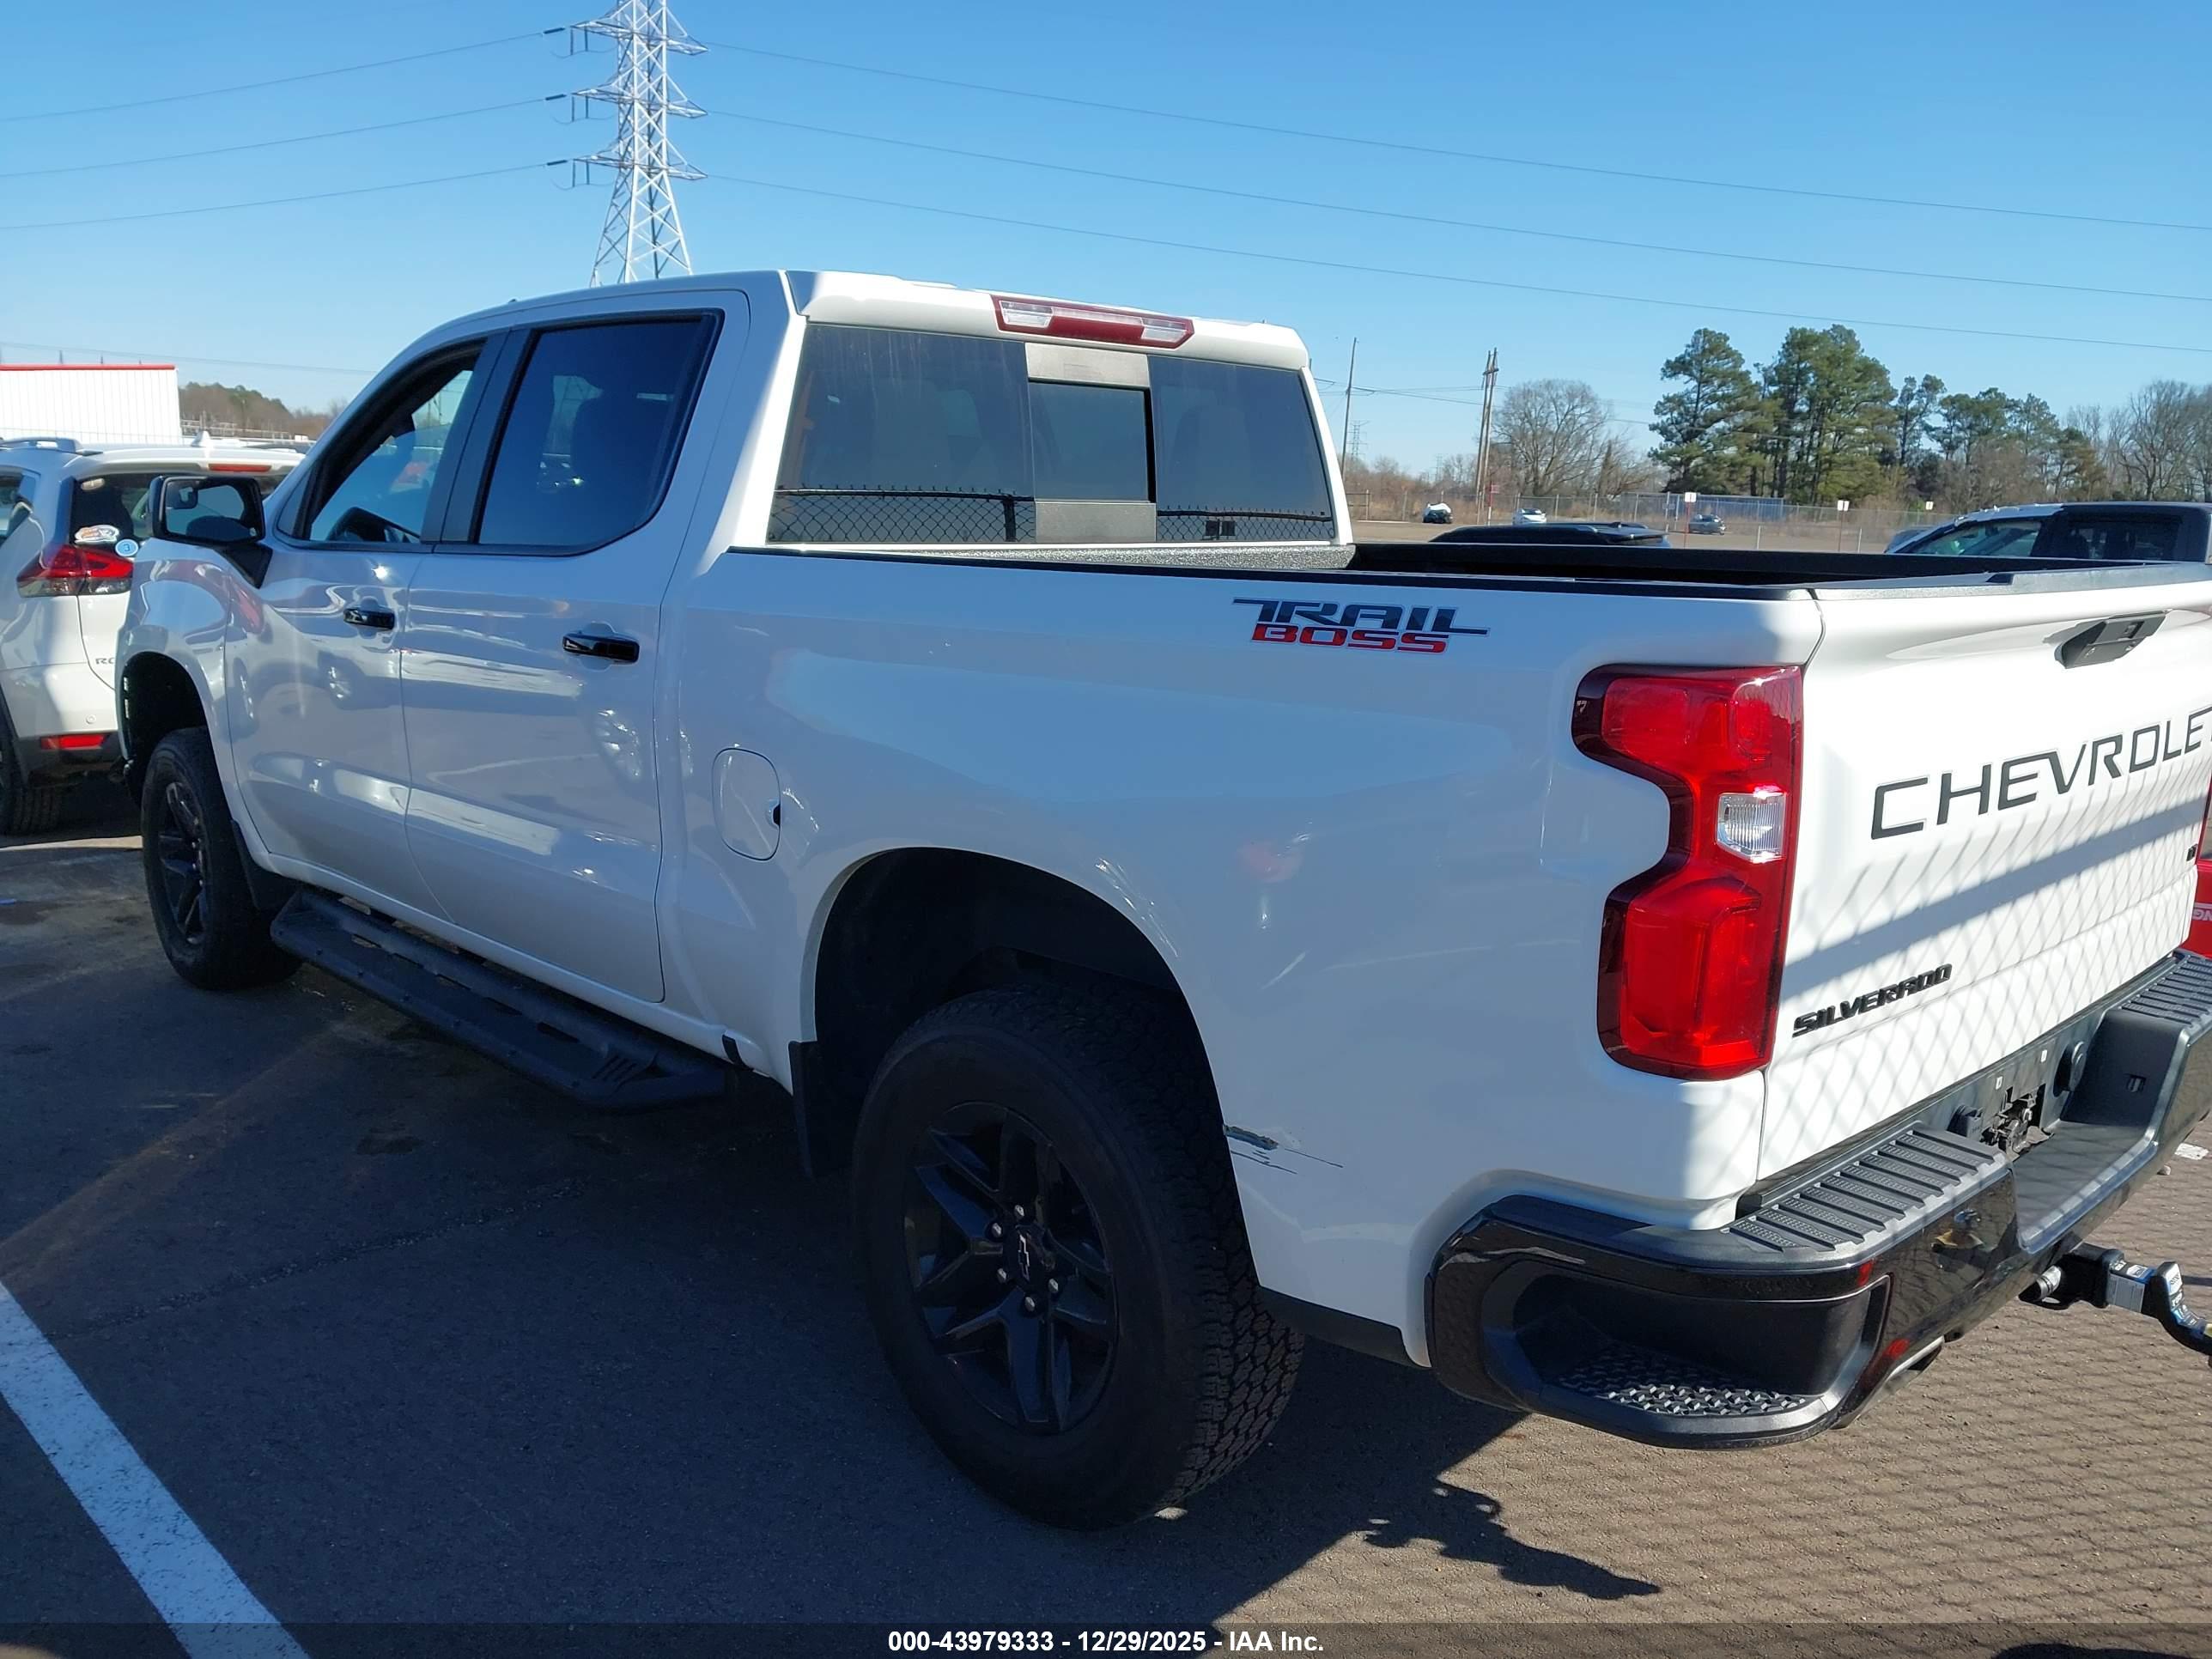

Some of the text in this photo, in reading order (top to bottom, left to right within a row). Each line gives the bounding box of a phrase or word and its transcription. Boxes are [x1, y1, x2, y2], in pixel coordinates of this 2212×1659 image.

[1233, 598, 1489, 635] TRAIL
[1251, 623, 1449, 653] BOSS
[1870, 706, 2212, 840] CHEVROLE
[1791, 963, 1953, 1038] SILVERADO
